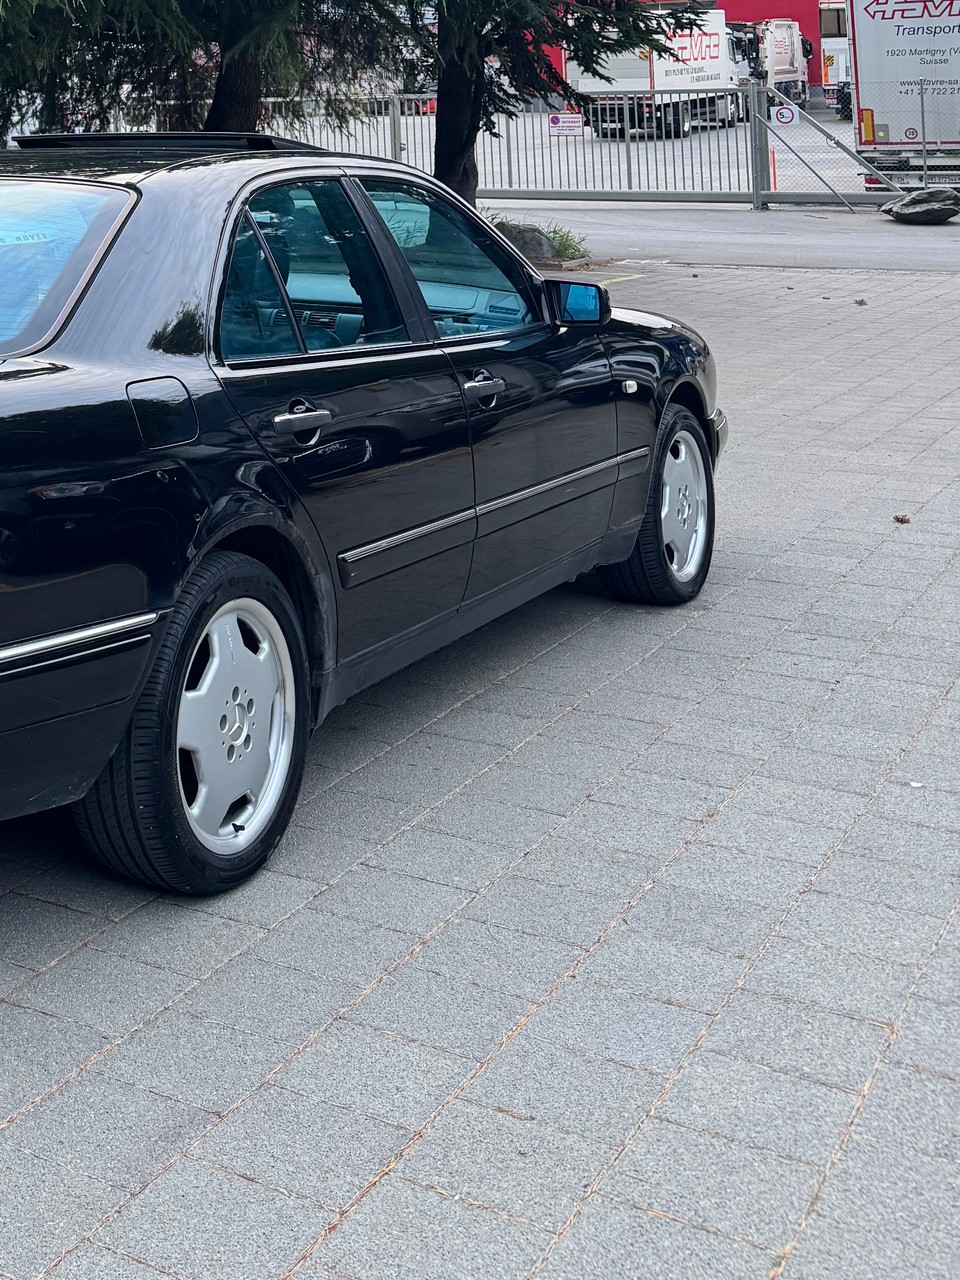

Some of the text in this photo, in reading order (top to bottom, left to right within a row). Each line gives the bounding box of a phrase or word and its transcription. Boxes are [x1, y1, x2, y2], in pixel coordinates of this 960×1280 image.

[886, 49, 907, 57] 1920
[909, 47, 947, 57] Martigny
[919, 57, 949, 65] Suisse
[899, 88, 914, 96] +41
[931, 87, 947, 95] 722
[779, 111, 785, 119] 5
